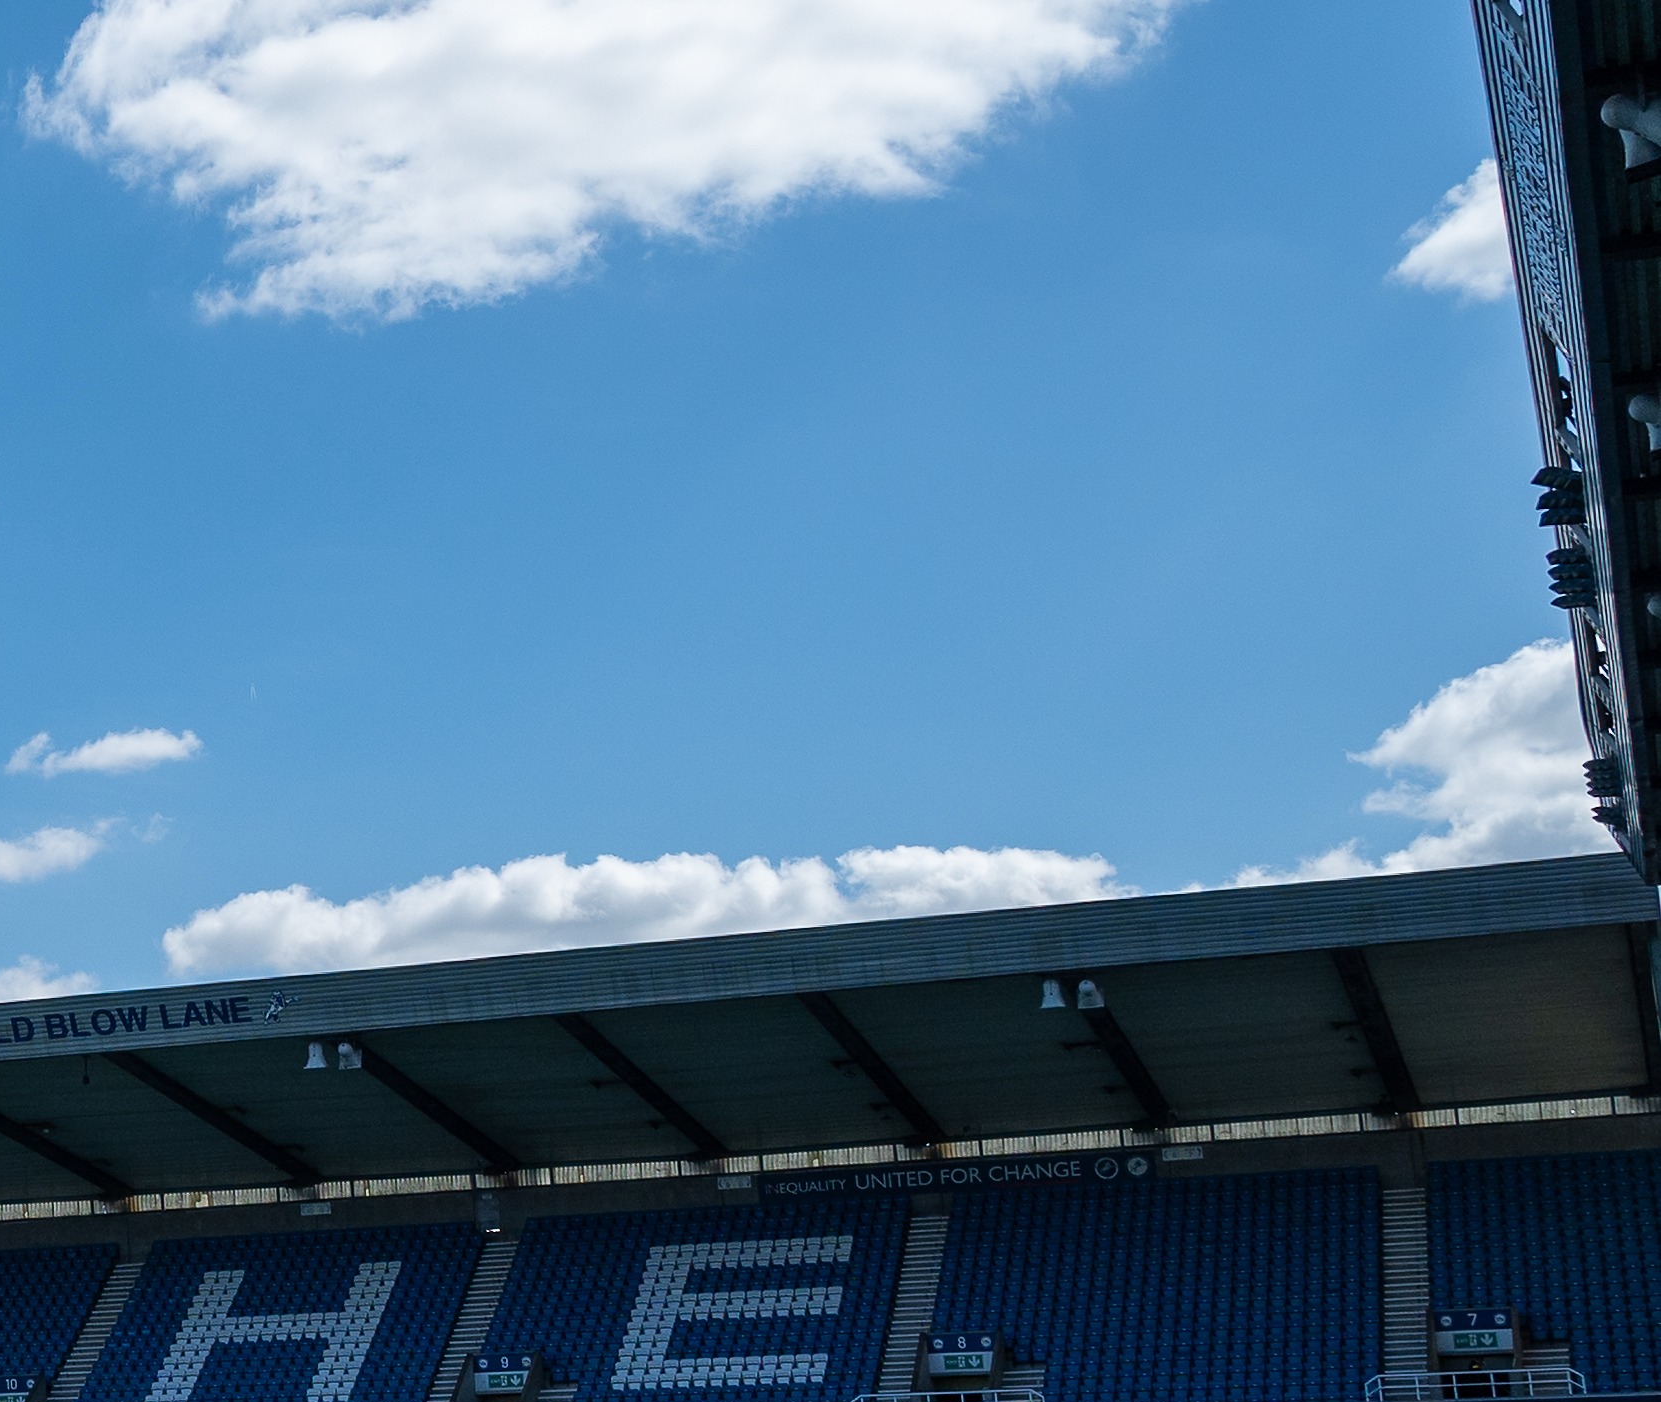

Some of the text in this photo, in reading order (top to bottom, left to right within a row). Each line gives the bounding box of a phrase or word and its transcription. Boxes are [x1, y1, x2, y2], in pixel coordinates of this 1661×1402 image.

[45, 1004, 148, 1041] BLOW
[161, 996, 253, 1029] LANE
[765, 1179, 846, 1195] INEQUALITY
[855, 1170, 933, 1191] UNITED
[940, 1167, 982, 1185] FOR
[989, 1161, 1081, 1182] CHANGE
[1467, 1312, 1477, 1326] 7
[957, 1336, 966, 1349] 8
[6, 1378, 18, 1390] 10
